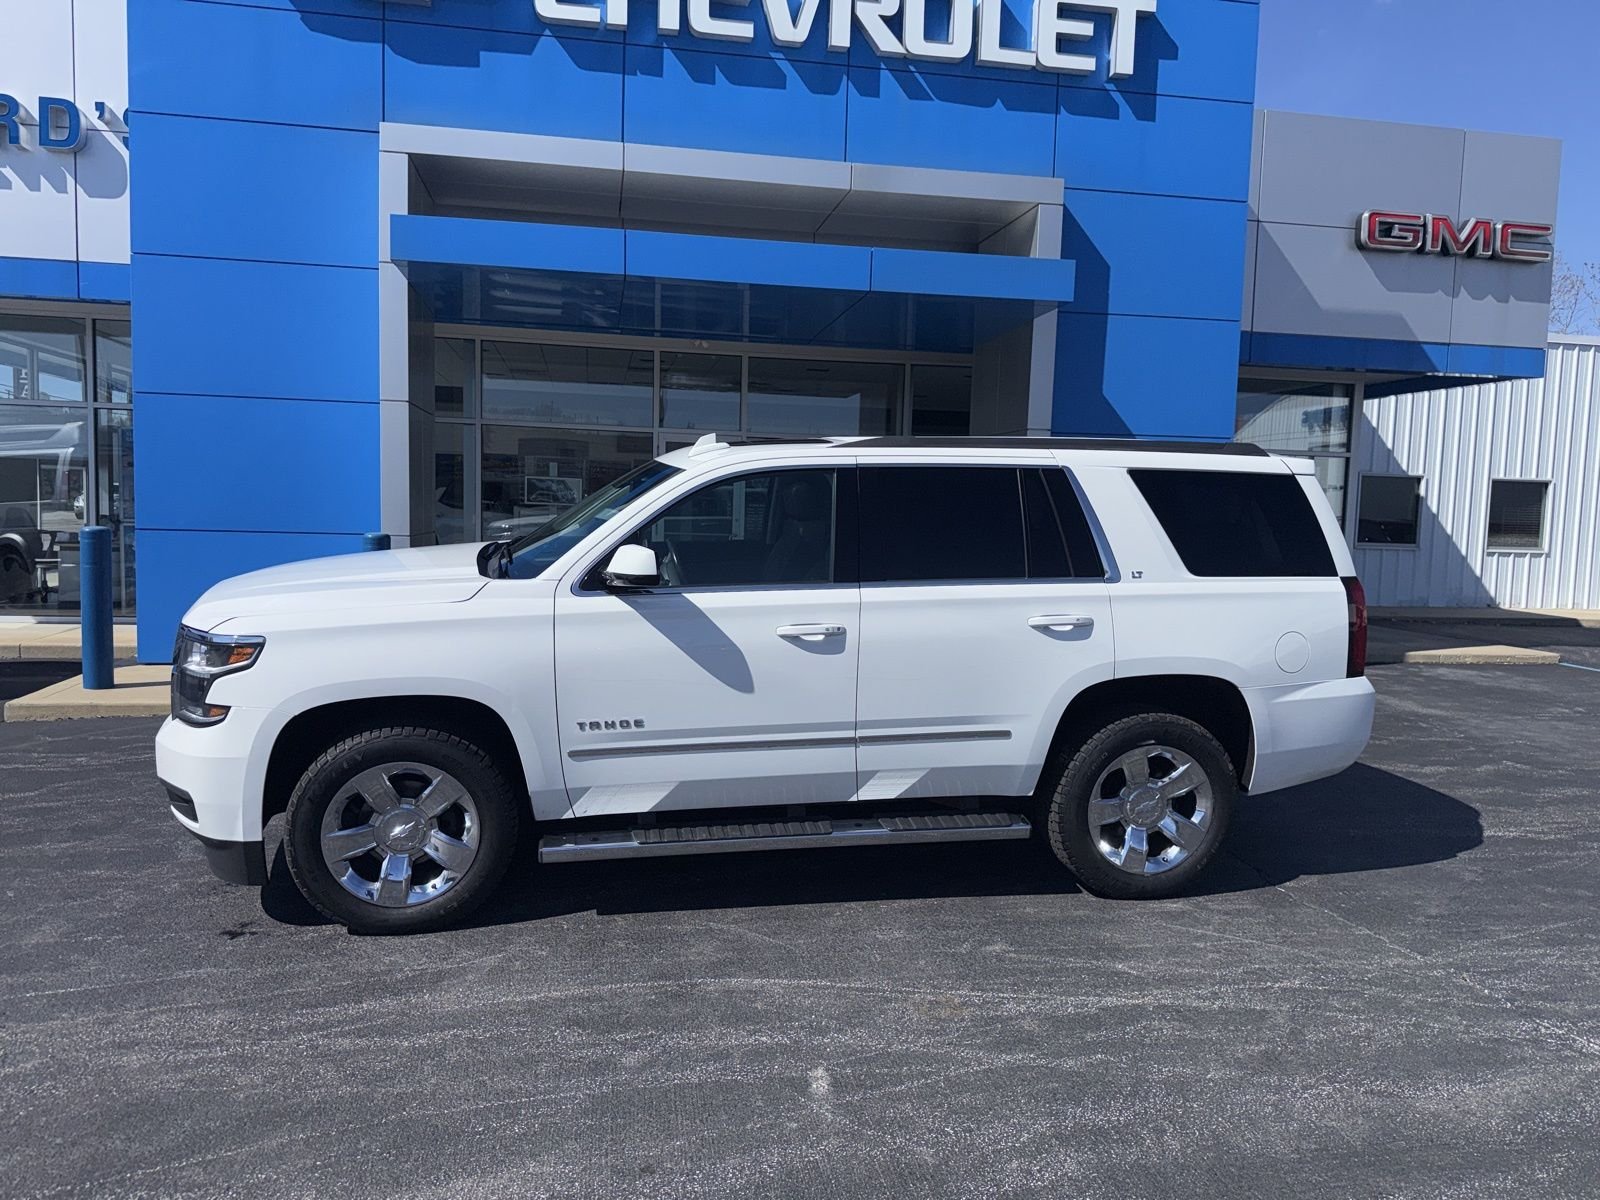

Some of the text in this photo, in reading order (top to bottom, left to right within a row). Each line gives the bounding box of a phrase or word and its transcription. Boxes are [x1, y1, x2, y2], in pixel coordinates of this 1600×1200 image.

[535, 0, 1157, 78] VROLET
[1357, 209, 1553, 263] GMC
[1131, 570, 1144, 579] LT
[576, 718, 646, 732] TAHOE
